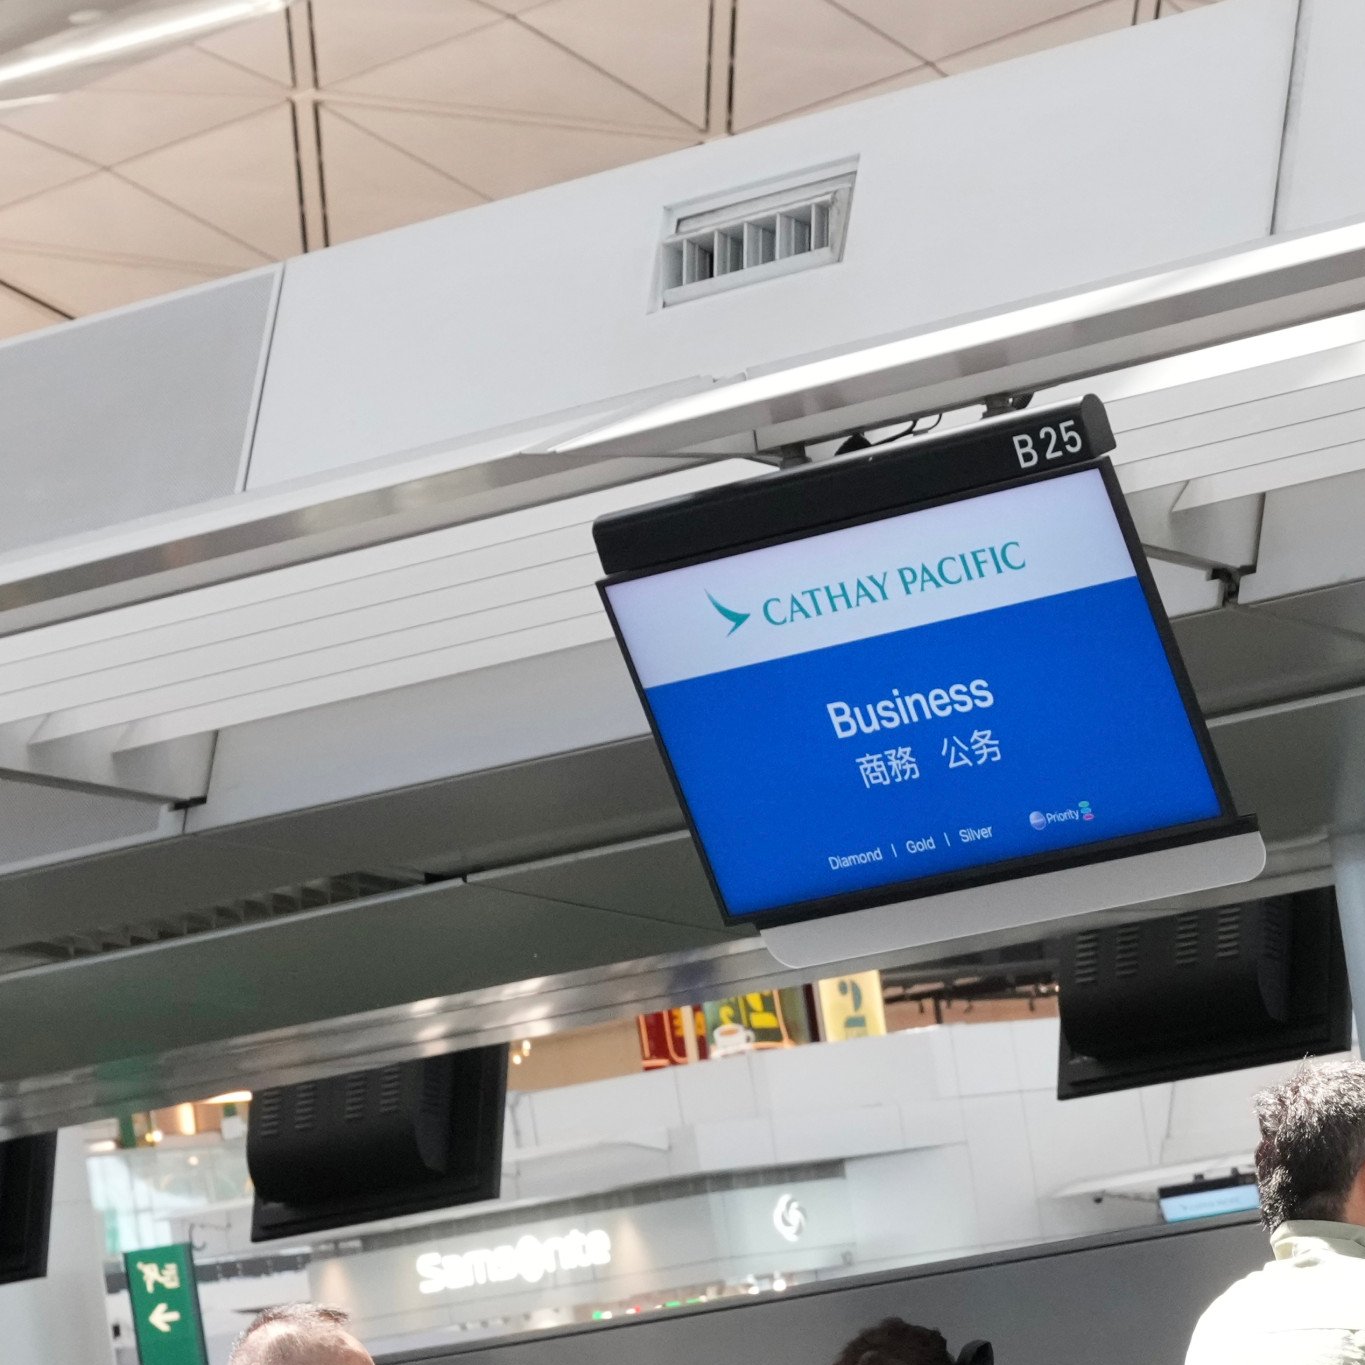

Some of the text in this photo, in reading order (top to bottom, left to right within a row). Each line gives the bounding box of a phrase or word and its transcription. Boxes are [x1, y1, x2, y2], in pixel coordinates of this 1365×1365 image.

[1012, 420, 1083, 469] B25
[762, 541, 1026, 626] CATHAY PACIFIC
[826, 678, 994, 739] Business
[855, 729, 1002, 789] 商務 公务
[1045, 808, 1080, 824] Priority
[828, 824, 993, 870] Diamond Gold Silver
